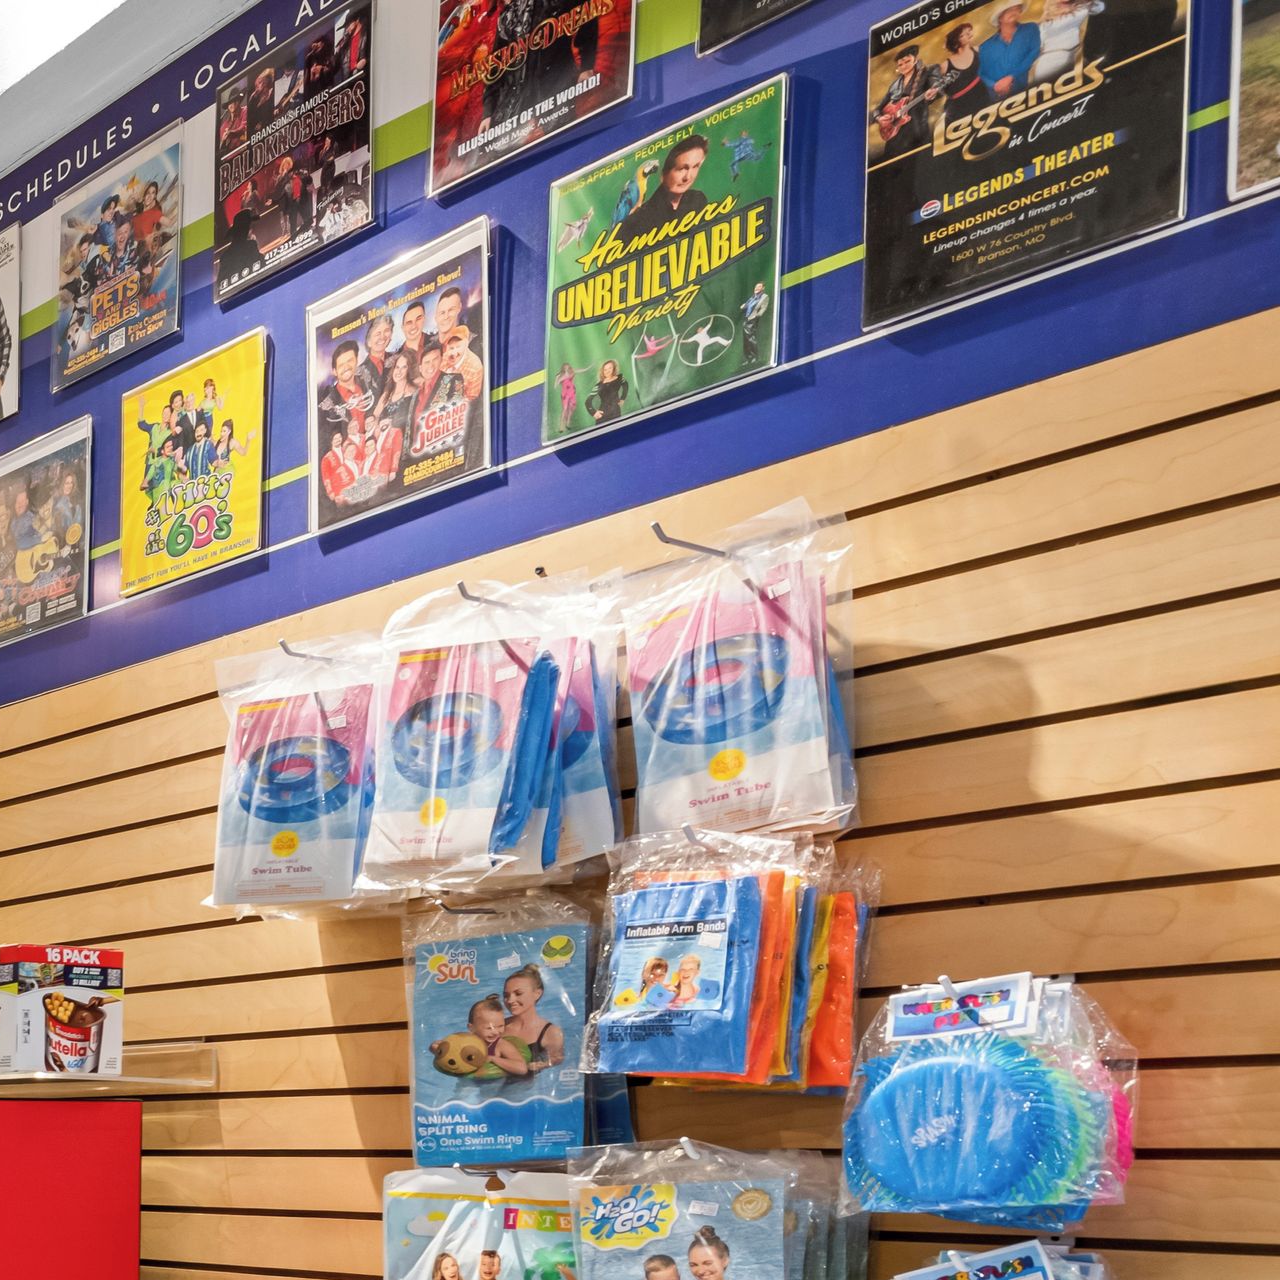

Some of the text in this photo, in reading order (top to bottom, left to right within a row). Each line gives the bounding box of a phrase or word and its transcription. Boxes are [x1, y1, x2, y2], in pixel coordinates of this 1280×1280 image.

[880, 8, 941, 44] WORLD'S
[179, 22, 277, 101] LOCAL
[450, 0, 614, 98] MANSION DREAMS
[250, 88, 329, 144] BRANSON'S FAMOUS
[457, 72, 600, 156] ILLUSIONIST OF THE WORLD!
[932, 56, 1106, 160] Legends
[1008, 93, 1095, 149] in Concert
[219, 81, 366, 200] BALDKNOBBERS
[484, 136, 512, 154] World
[537, 105, 570, 127] Awards
[586, 86, 775, 186] APPEAR PEOPLE FLY VOICES SOAR
[943, 168, 1026, 213] LEGENDS
[1031, 132, 1116, 175] THEATER
[923, 165, 1110, 245] LEGENDSINCONCERT.COM
[932, 187, 1098, 255] Lineup changes times year.
[576, 194, 738, 273] Hamners
[950, 211, 1076, 264] 1600 W 76 Country Blvd.
[1025, 234, 1046, 250] MO
[557, 205, 765, 323] UNBELIEVABLE
[92, 271, 139, 317] PETS
[106, 301, 121, 317] AND
[331, 313, 367, 338] Branson's
[388, 280, 435, 309] Entertaining
[436, 265, 462, 289] Show!
[607, 283, 700, 344] Variety
[91, 303, 138, 337] GIGGLES
[425, 402, 467, 429] GRAND
[411, 417, 465, 454] JUBILEE
[173, 472, 233, 511] Hits
[166, 501, 233, 558] 60's
[192, 552, 210, 565] HAVE
[688, 779, 772, 809] Swim Tube
[251, 863, 313, 876] Swim Tube
[626, 920, 726, 938] Inflatable Arm Bands
[45, 948, 101, 965] 16 PACK
[436, 964, 479, 984] Sun
[450, 950, 476, 961] bring
[418, 1114, 469, 1124] ANIMAL
[418, 1124, 488, 1136] SPLIT RING
[440, 1134, 523, 1146] One Swim Ring
[505, 1208, 572, 1232] INTE
[595, 1196, 640, 1222] H2O
[614, 1205, 661, 1233] GO!
